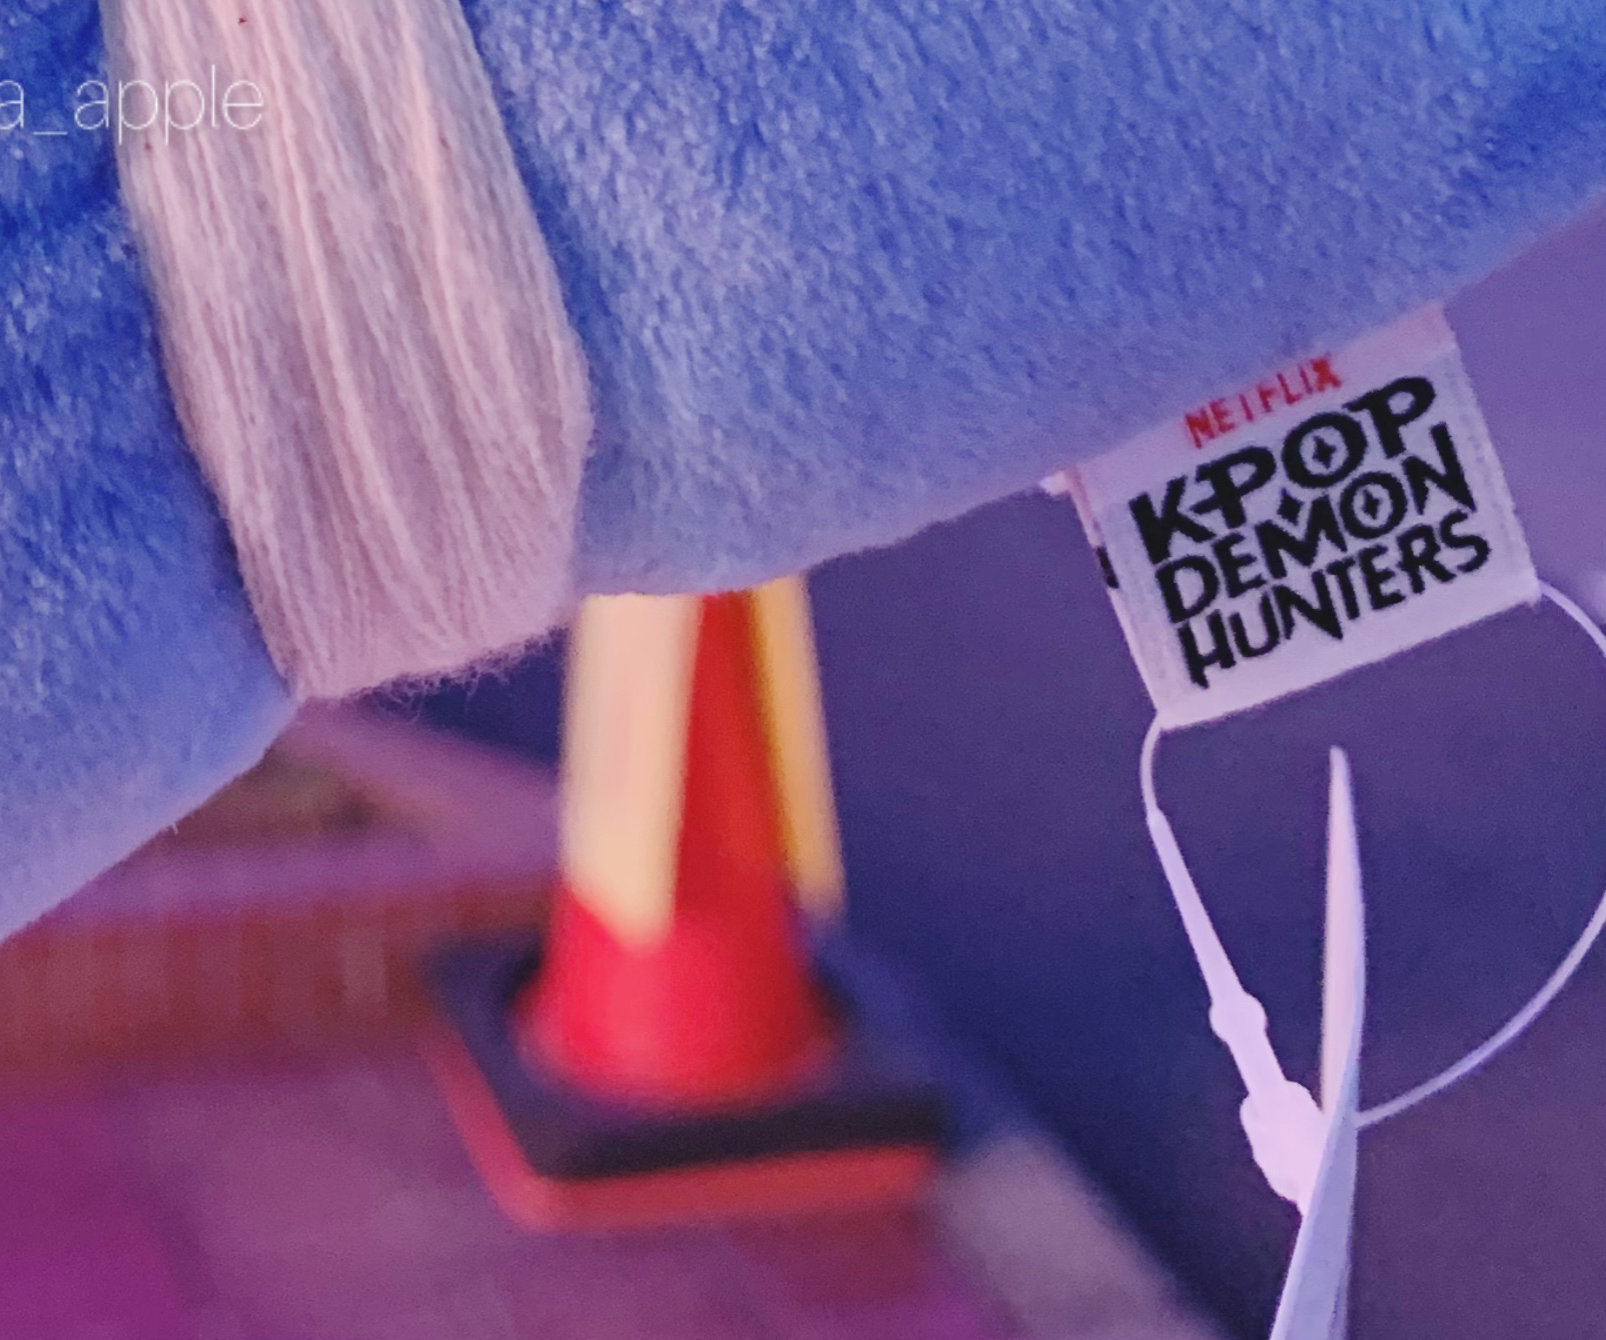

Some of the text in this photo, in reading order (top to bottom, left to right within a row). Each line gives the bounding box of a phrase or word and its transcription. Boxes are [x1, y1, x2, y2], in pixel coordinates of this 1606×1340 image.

[1183, 356, 1343, 450] NETFLIX
[1155, 421, 1478, 624] DEMON
[1177, 510, 1492, 690] HUNTERS
